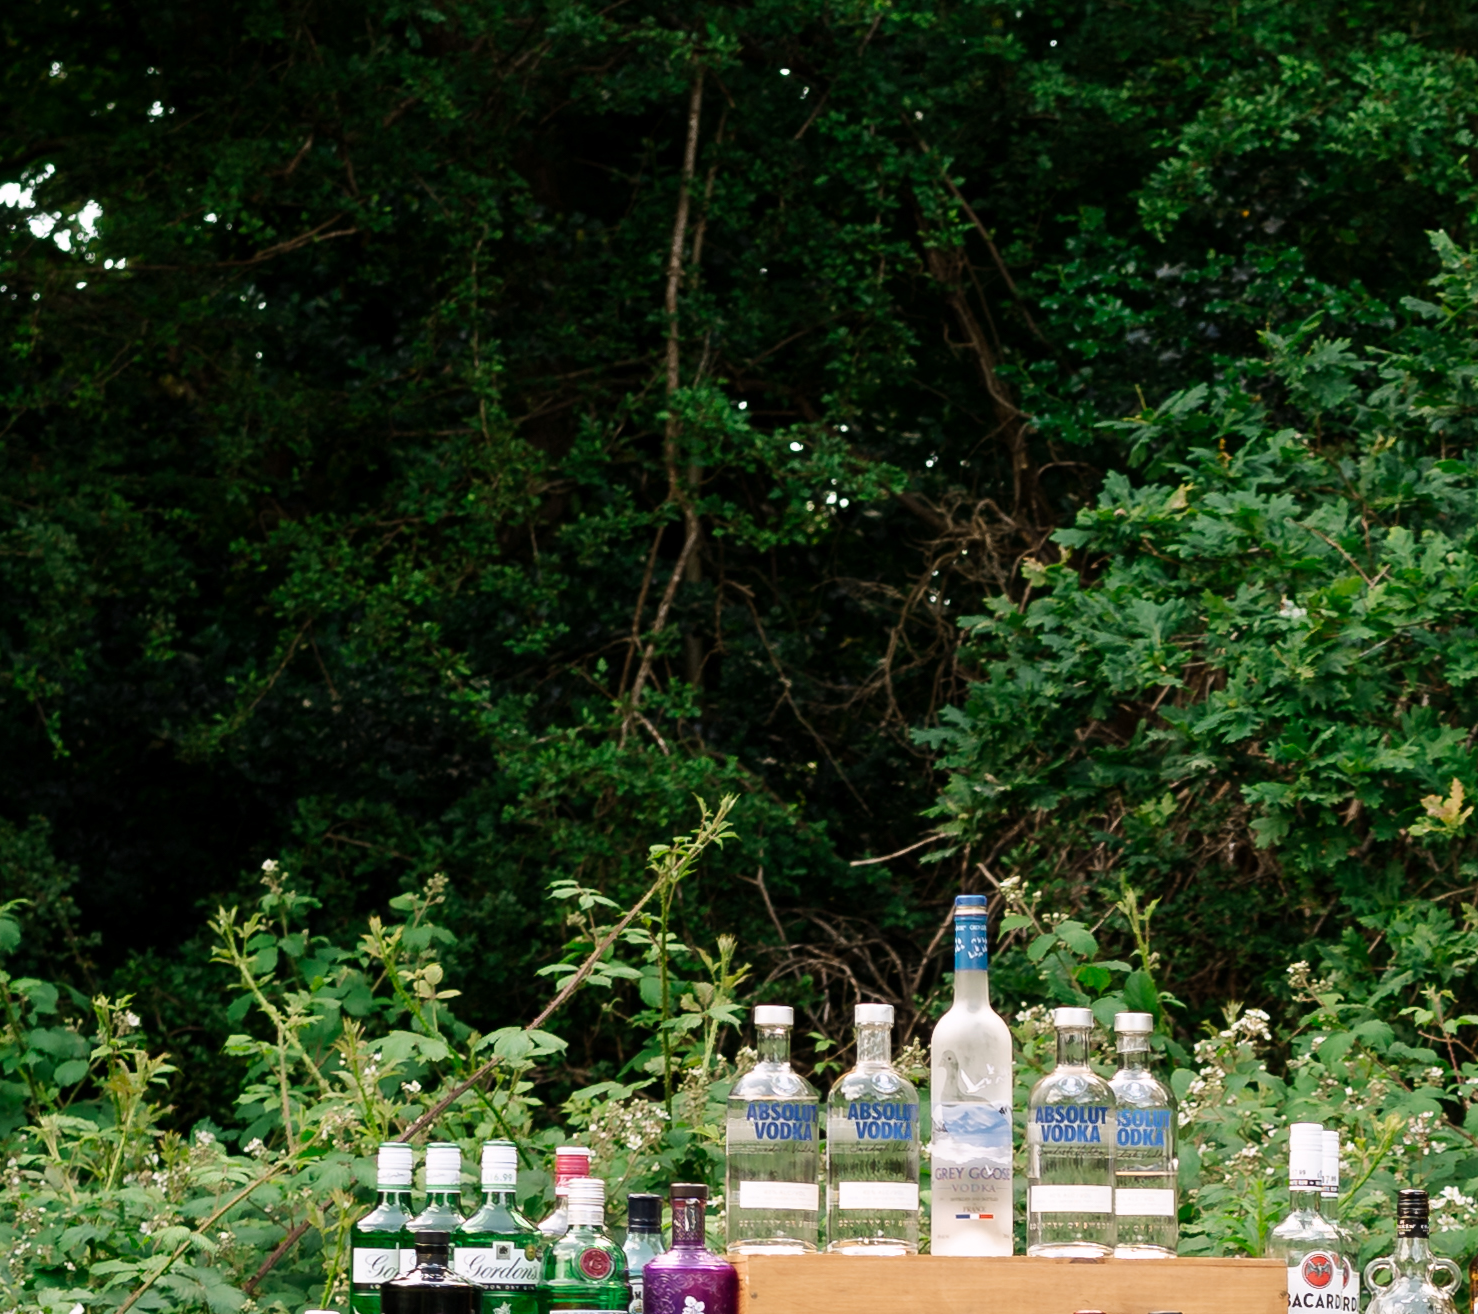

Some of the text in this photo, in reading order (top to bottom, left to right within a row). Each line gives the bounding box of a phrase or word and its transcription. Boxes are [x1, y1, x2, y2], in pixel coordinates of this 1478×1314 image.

[746, 1103, 817, 1123] ABSOLUT
[847, 1102, 918, 1123] ABSOLUT
[1035, 1105, 1109, 1125] ABSOLUT
[754, 1122, 812, 1141] VODKA
[855, 1121, 913, 1141] VODKA
[1041, 1124, 1101, 1143] VODKA
[1117, 1128, 1164, 1147] ODKA
[934, 1166, 1011, 1181] GREY GOOSE
[952, 1183, 996, 1193] VODKA
